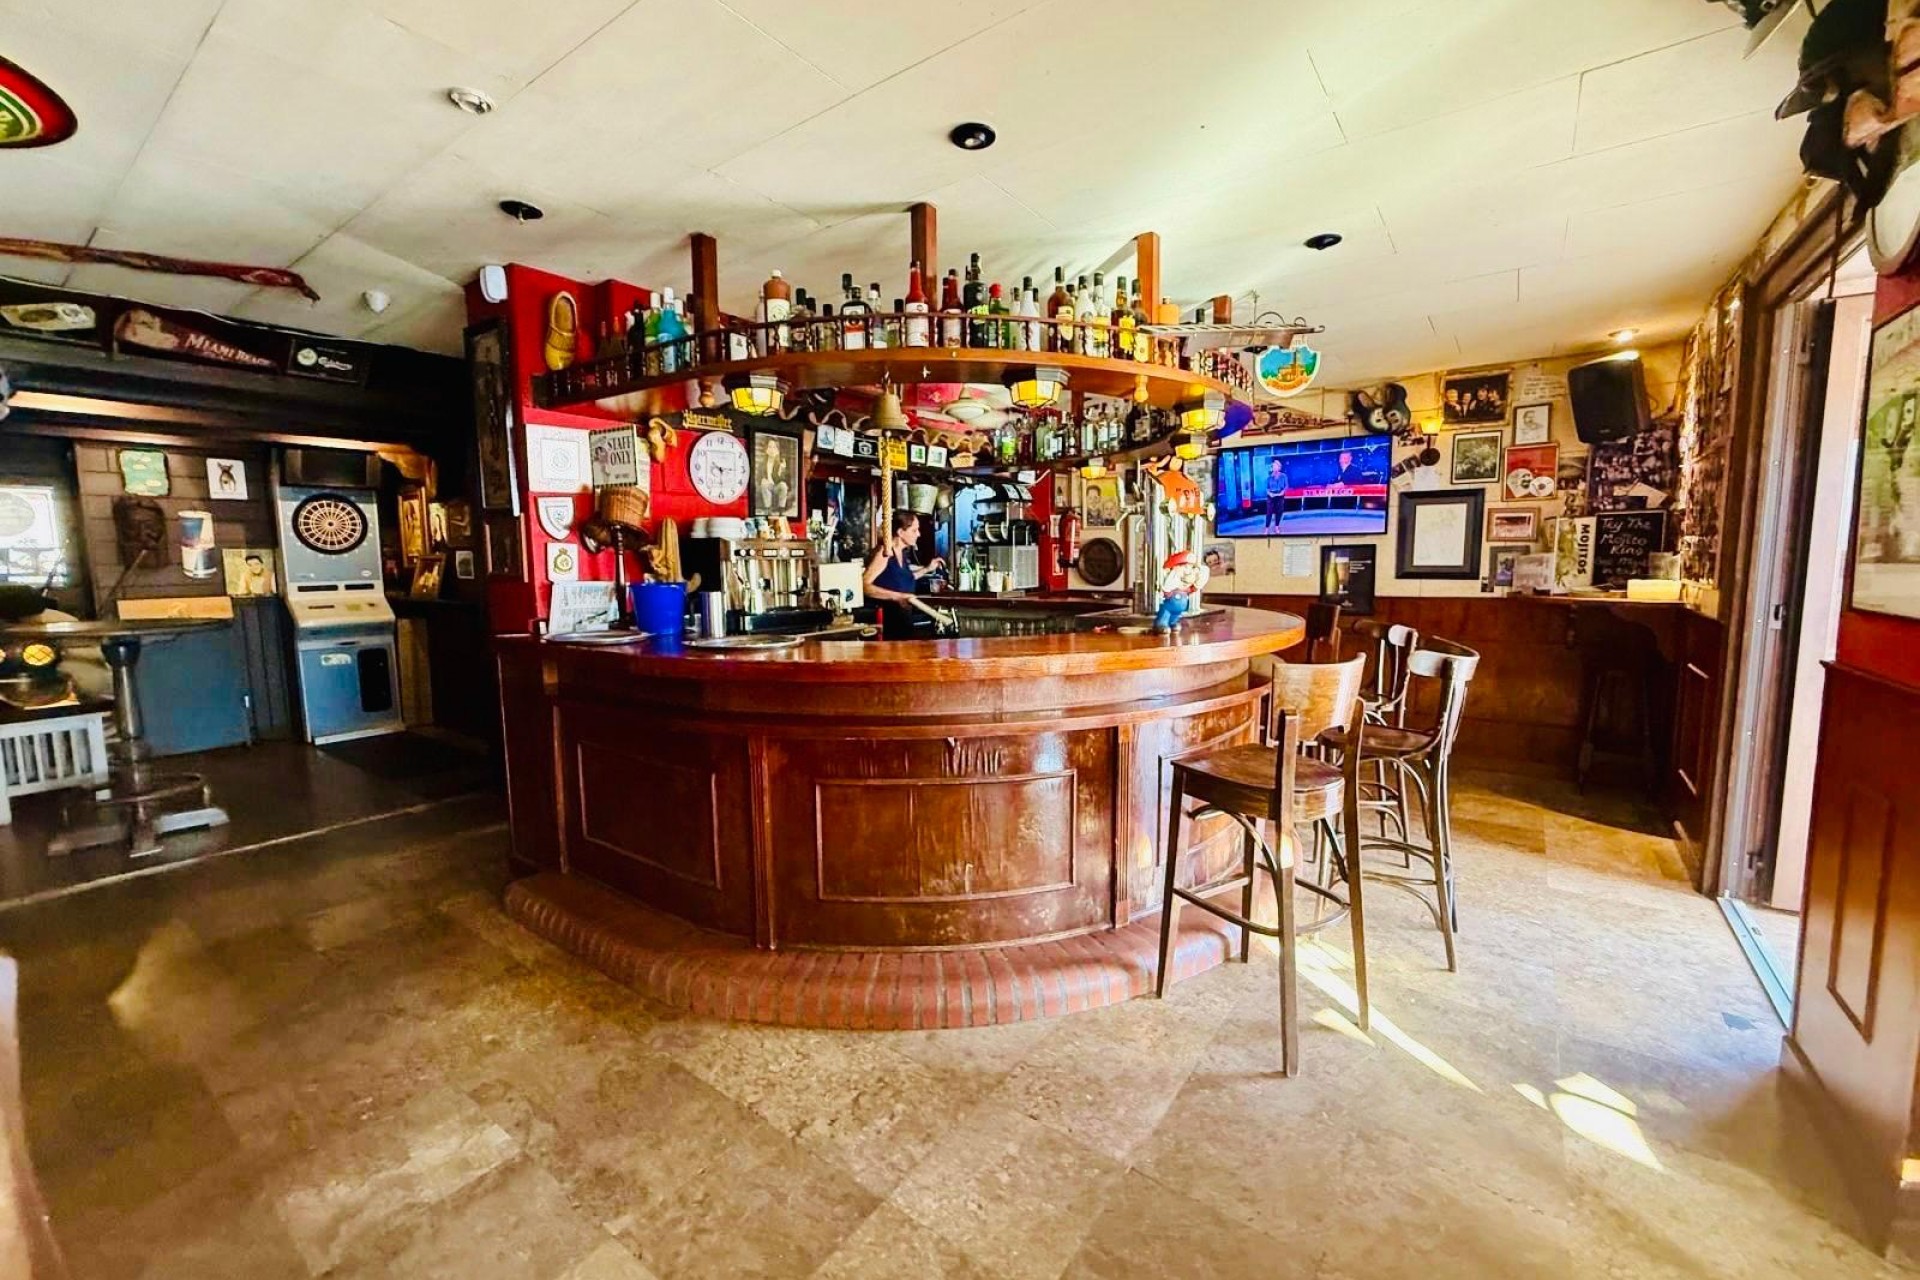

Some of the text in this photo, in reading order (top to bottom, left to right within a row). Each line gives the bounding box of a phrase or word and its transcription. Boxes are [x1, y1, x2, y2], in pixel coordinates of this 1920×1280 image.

[185, 333, 235, 358] MIAMI
[607, 435, 632, 451] STAFF
[610, 450, 631, 467] ONLY
[1577, 523, 1591, 575] MOJITOS
